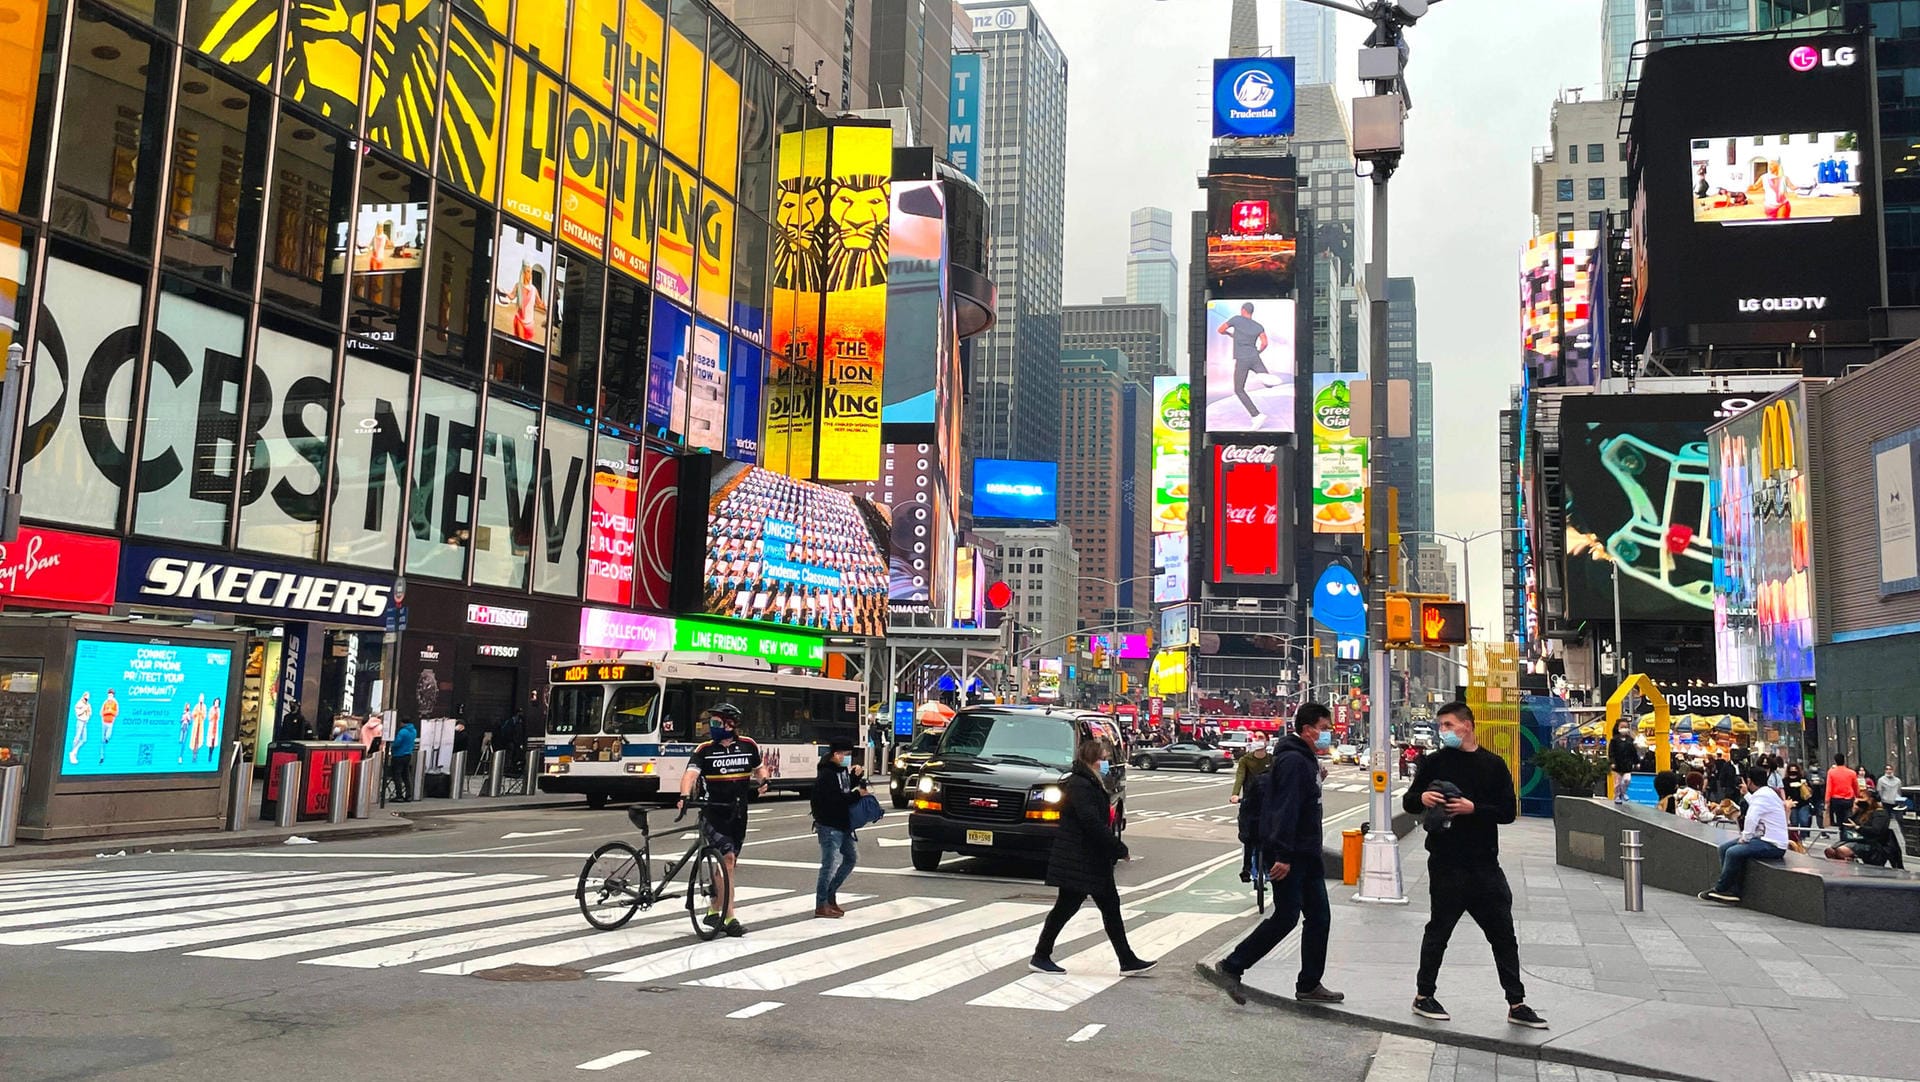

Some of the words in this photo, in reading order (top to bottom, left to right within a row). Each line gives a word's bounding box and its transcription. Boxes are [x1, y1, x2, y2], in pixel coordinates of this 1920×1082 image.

[600, 23, 661, 106] THE
[1821, 46, 1856, 68] LG
[1229, 108, 1277, 119] Prudential
[520, 45, 628, 205] LION
[631, 121, 724, 262] KING
[563, 219, 604, 250] ENTRANCE
[613, 246, 626, 262] ON
[629, 256, 648, 275] 45TH
[1738, 298, 1761, 313] LG
[1764, 297, 1802, 312] OLED
[1802, 296, 1827, 311] TV
[836, 341, 867, 357] THE
[828, 359, 873, 385] LION
[824, 387, 878, 419] KING
[1318, 405, 1351, 417] Gree
[79, 325, 340, 522] CBS
[764, 518, 796, 540] UNICEF
[763, 560, 801, 582] Pandemic
[802, 567, 840, 588] Classroom
[140, 556, 393, 618] SKECHERS
[489, 609, 527, 627] TISSOT
[490, 645, 519, 658] TISSOT
[691, 629, 712, 647] LINE
[712, 633, 748, 652] FRIENDS
[759, 638, 778, 655] NEW
[778, 640, 799, 657] YORK
[136, 648, 177, 660] CONNECT
[129, 658, 152, 670] YOUR
[153, 659, 182, 671] PHONE
[598, 667, 609, 680] 41
[612, 666, 625, 680] ST
[123, 670, 162, 682] PROTECT
[163, 672, 184, 683] YOUR
[128, 684, 177, 697] COMMUNITY
[1723, 690, 1747, 709] hu
[712, 757, 749, 768] COLOMBIA
